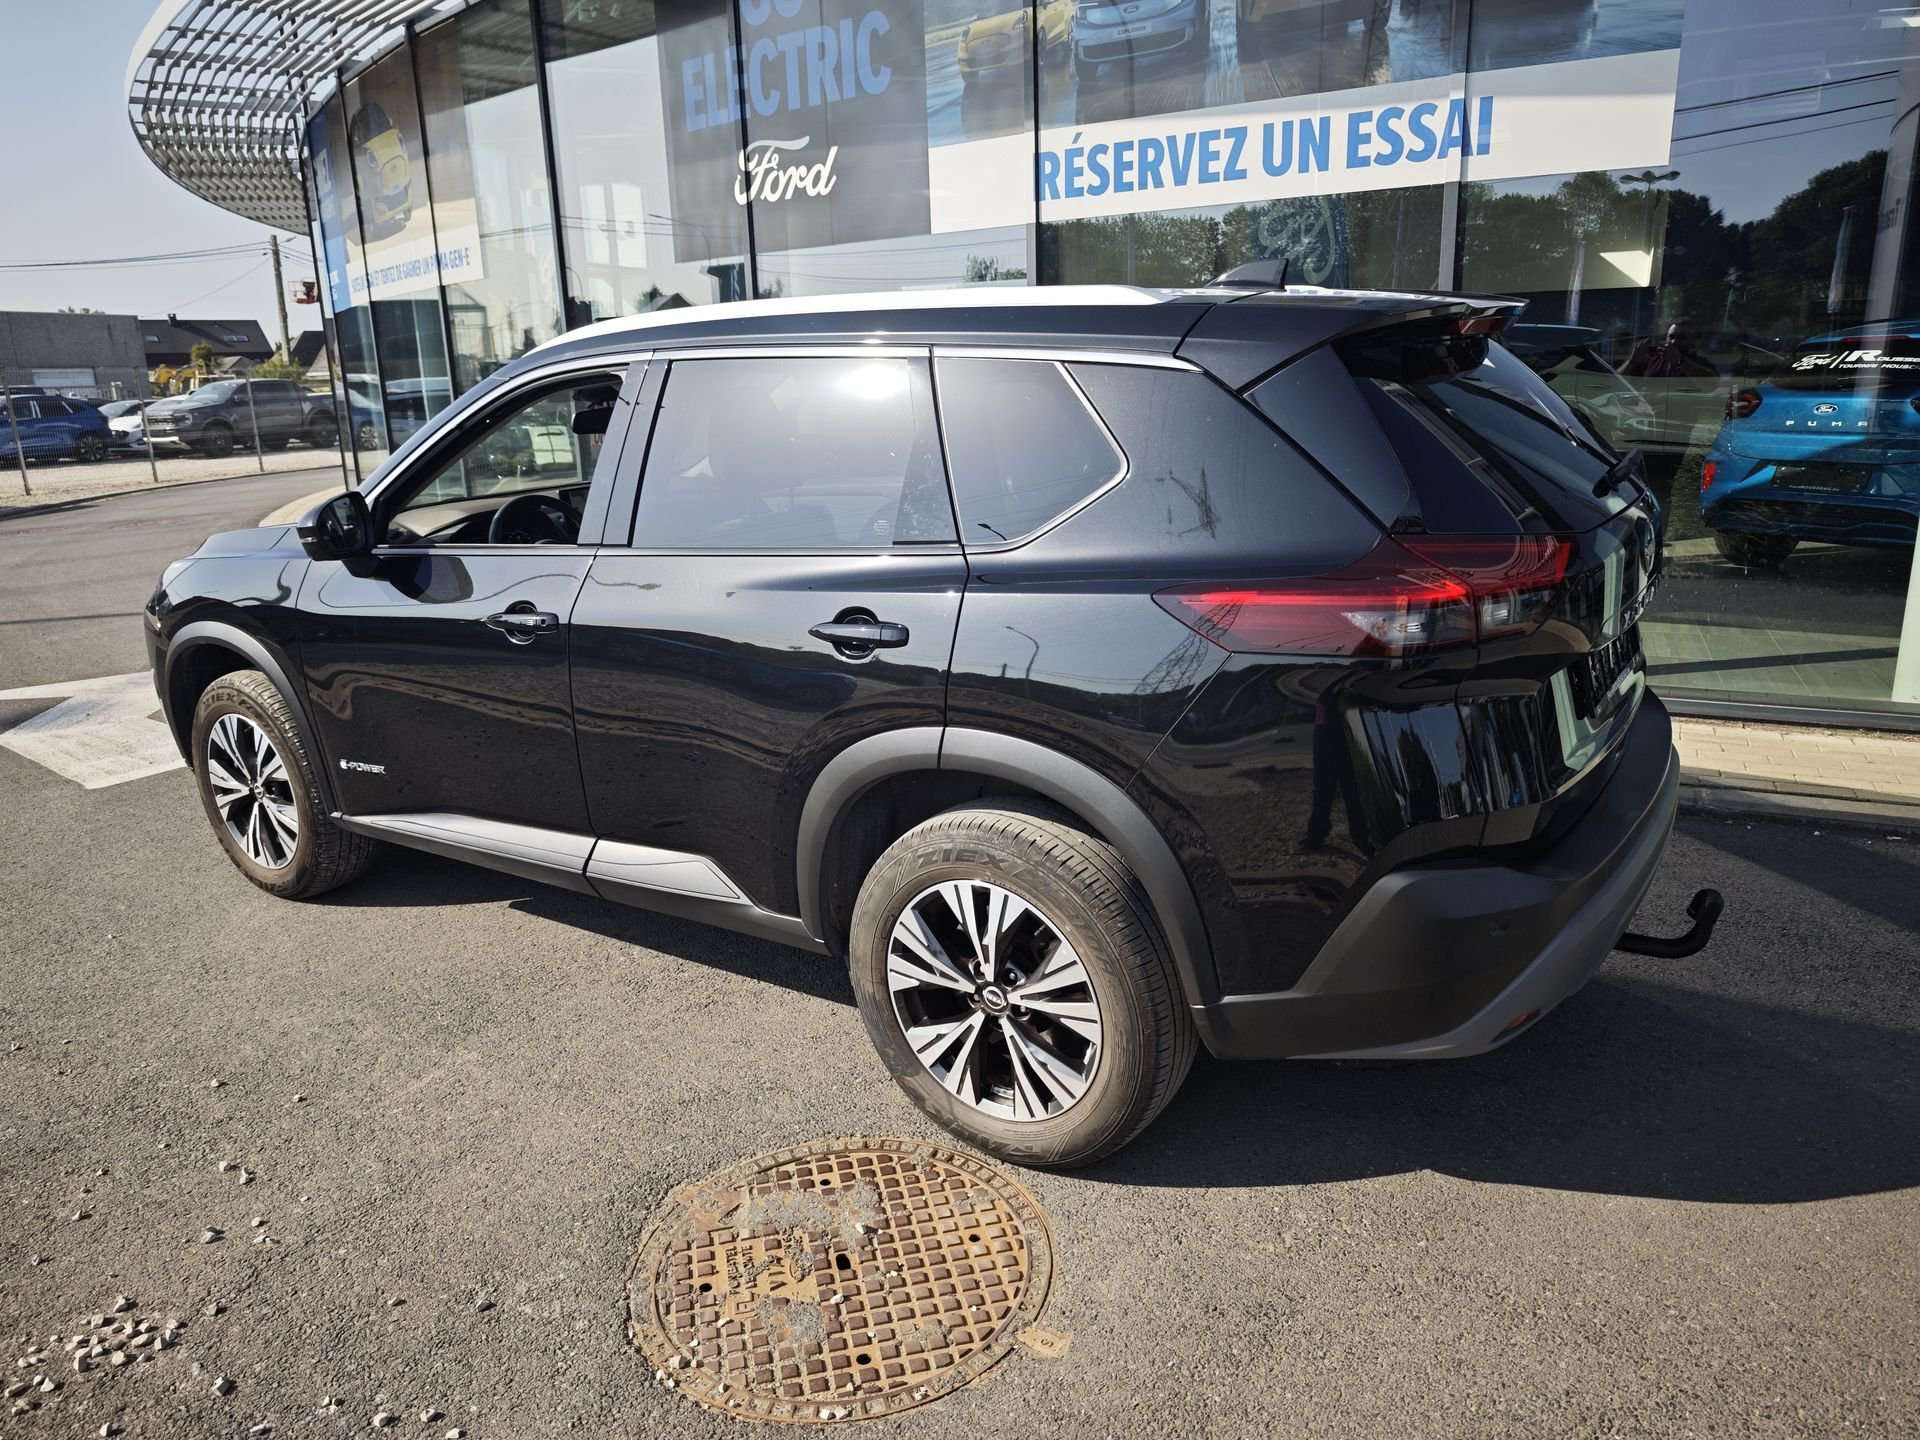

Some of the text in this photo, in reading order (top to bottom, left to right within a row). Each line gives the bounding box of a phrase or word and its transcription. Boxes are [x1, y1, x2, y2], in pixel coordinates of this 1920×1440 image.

[682, 10, 892, 131] ELECTRIC
[735, 135, 838, 205] Ford
[1034, 96, 1493, 201] RÉSERVEZ UN ESSAI
